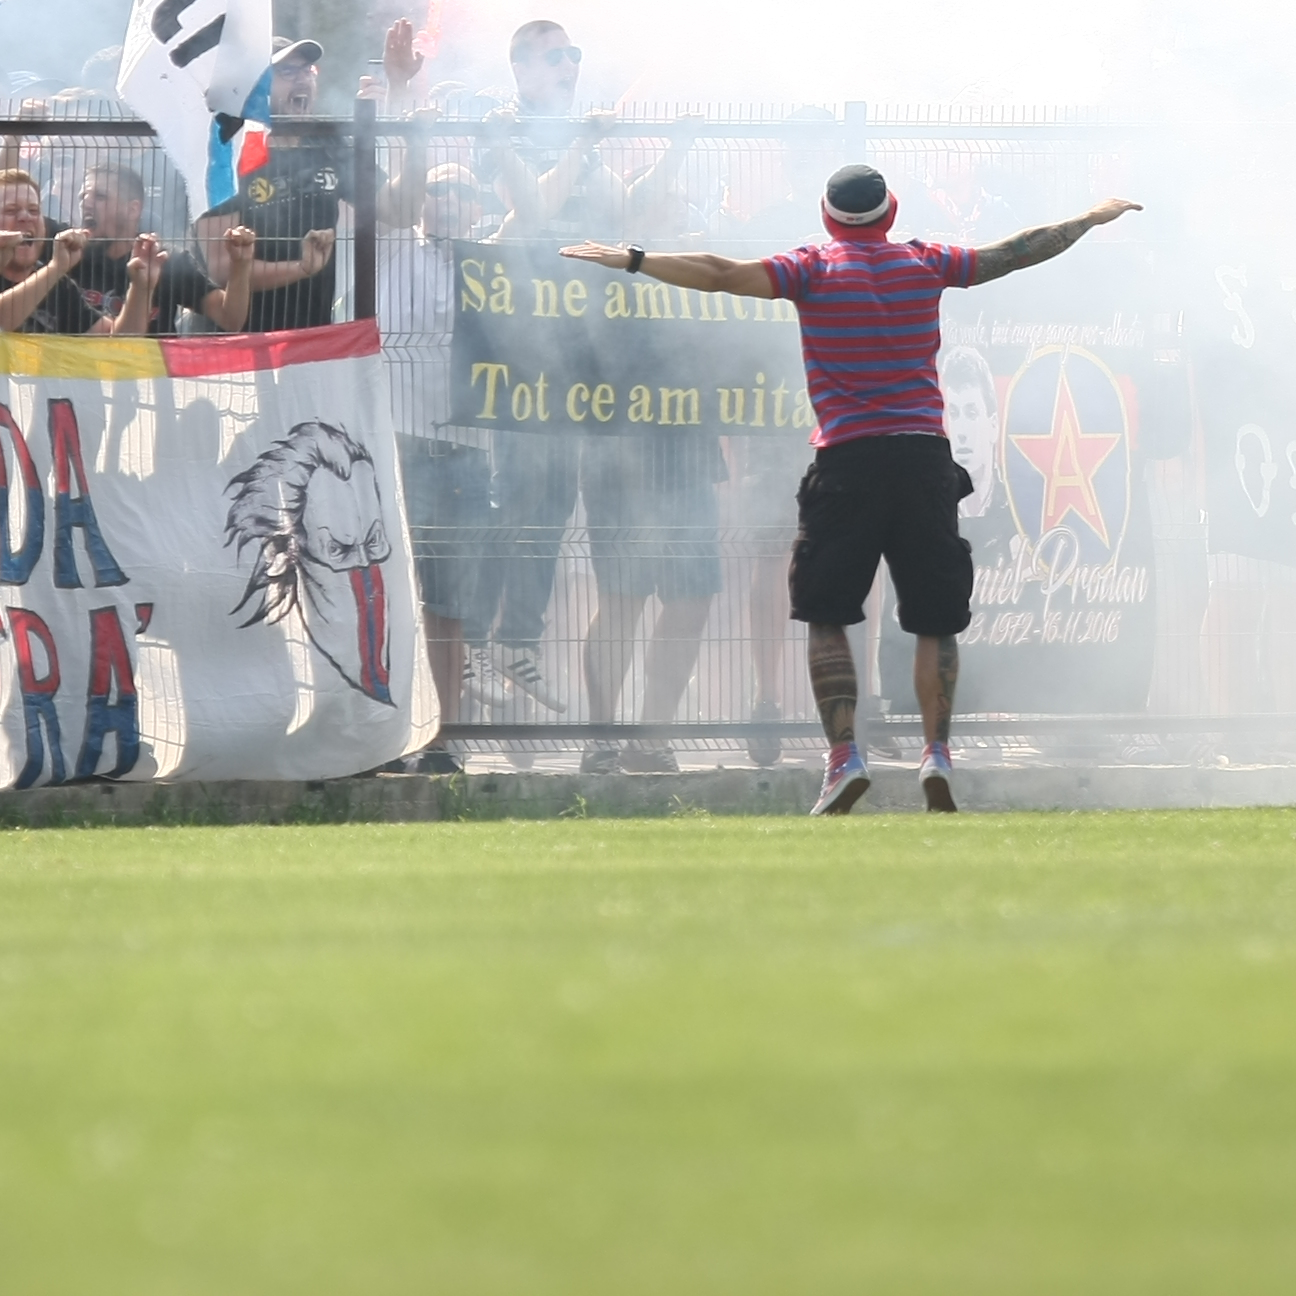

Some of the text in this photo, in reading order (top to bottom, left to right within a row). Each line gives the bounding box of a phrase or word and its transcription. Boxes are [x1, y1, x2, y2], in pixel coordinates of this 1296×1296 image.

[532, 278, 588, 318] ne
[470, 362, 549, 421] Tot
[566, 381, 616, 422] ce
[627, 383, 702, 426] am
[1032, 526, 1149, 620] Prodan
